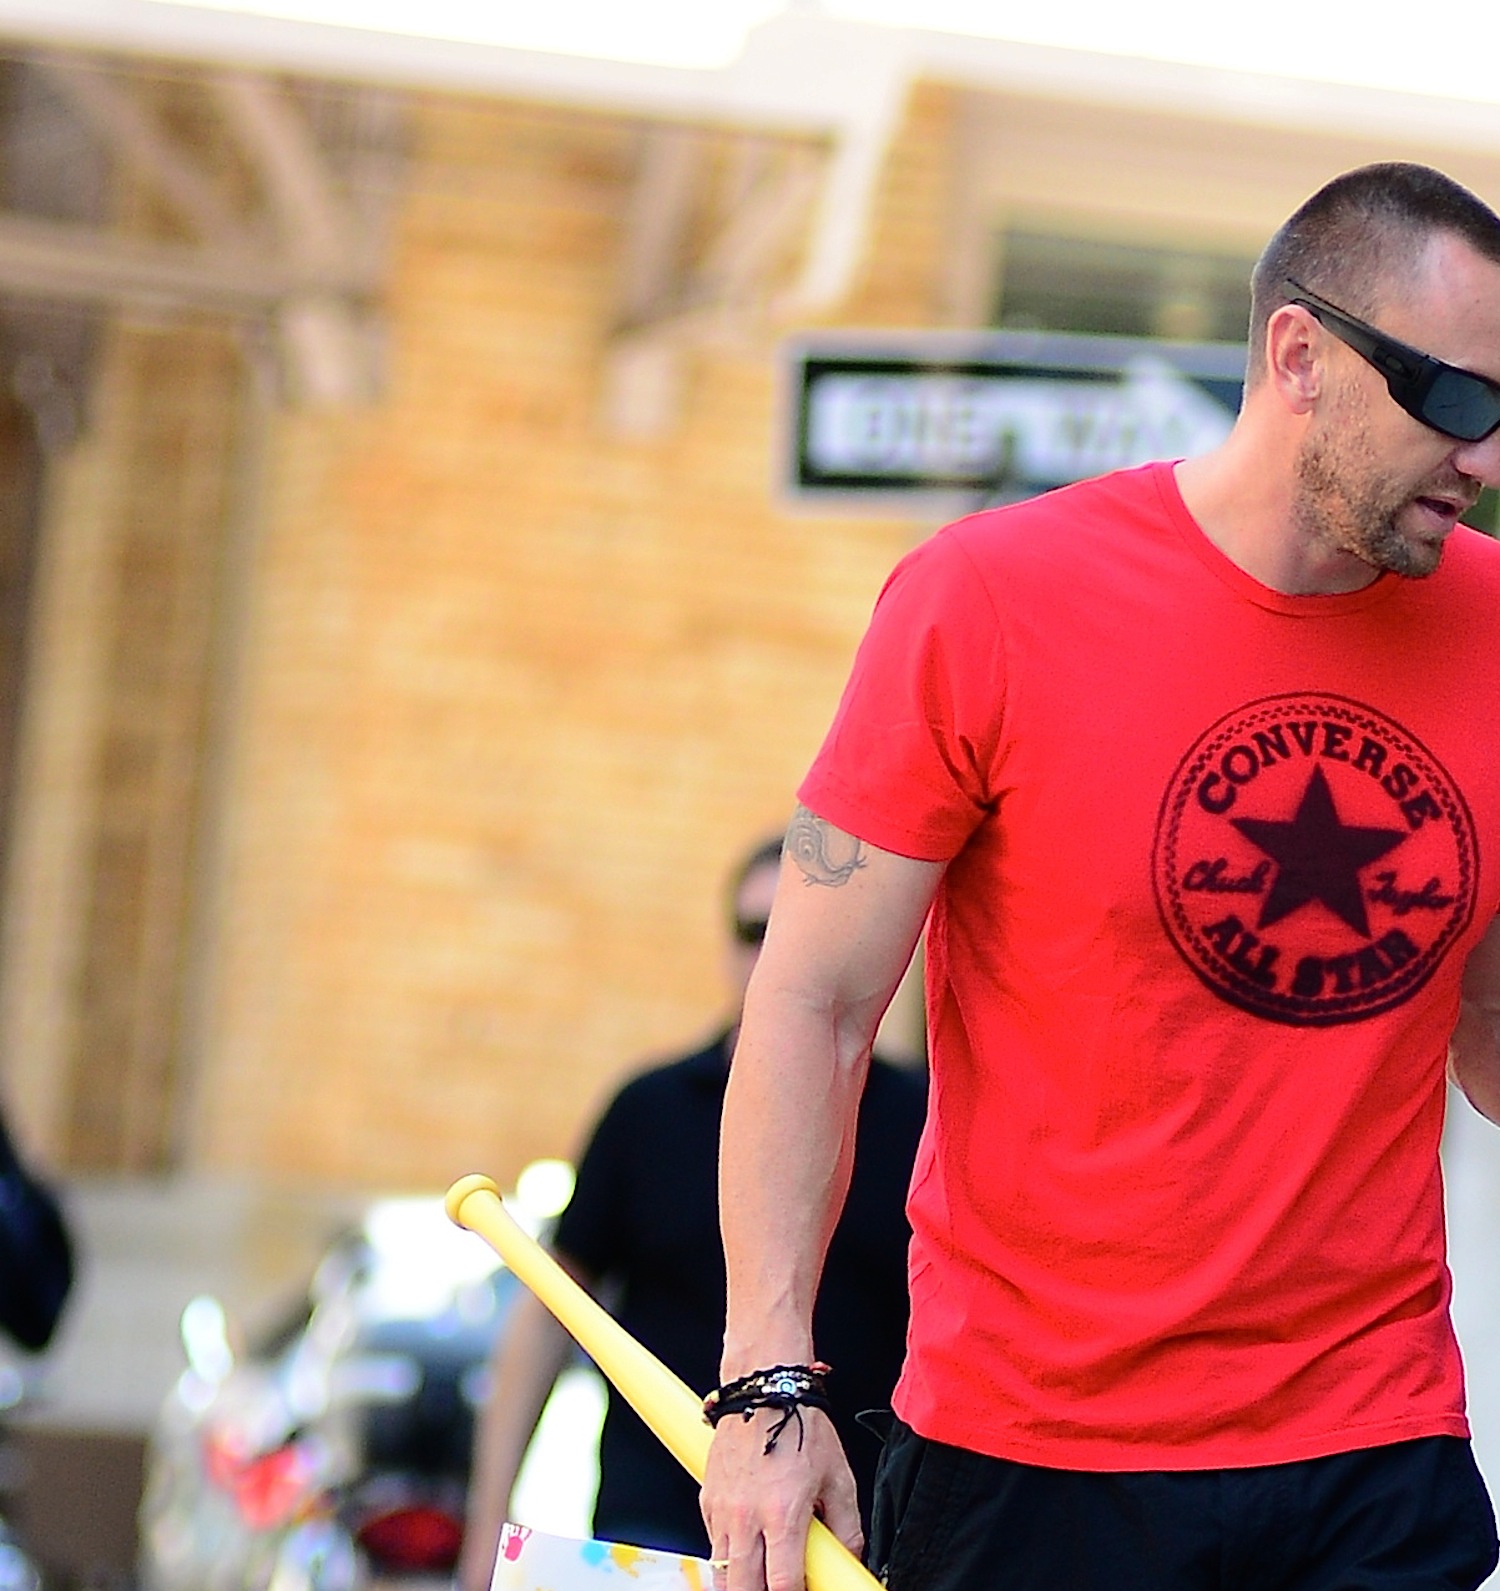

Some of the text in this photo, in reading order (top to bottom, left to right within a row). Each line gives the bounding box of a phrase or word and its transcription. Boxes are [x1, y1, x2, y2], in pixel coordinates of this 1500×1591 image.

[1197, 720, 1443, 830] CONVERSE
[1183, 858, 1271, 893] Chuck
[1202, 914, 1421, 998] ALL STAR
